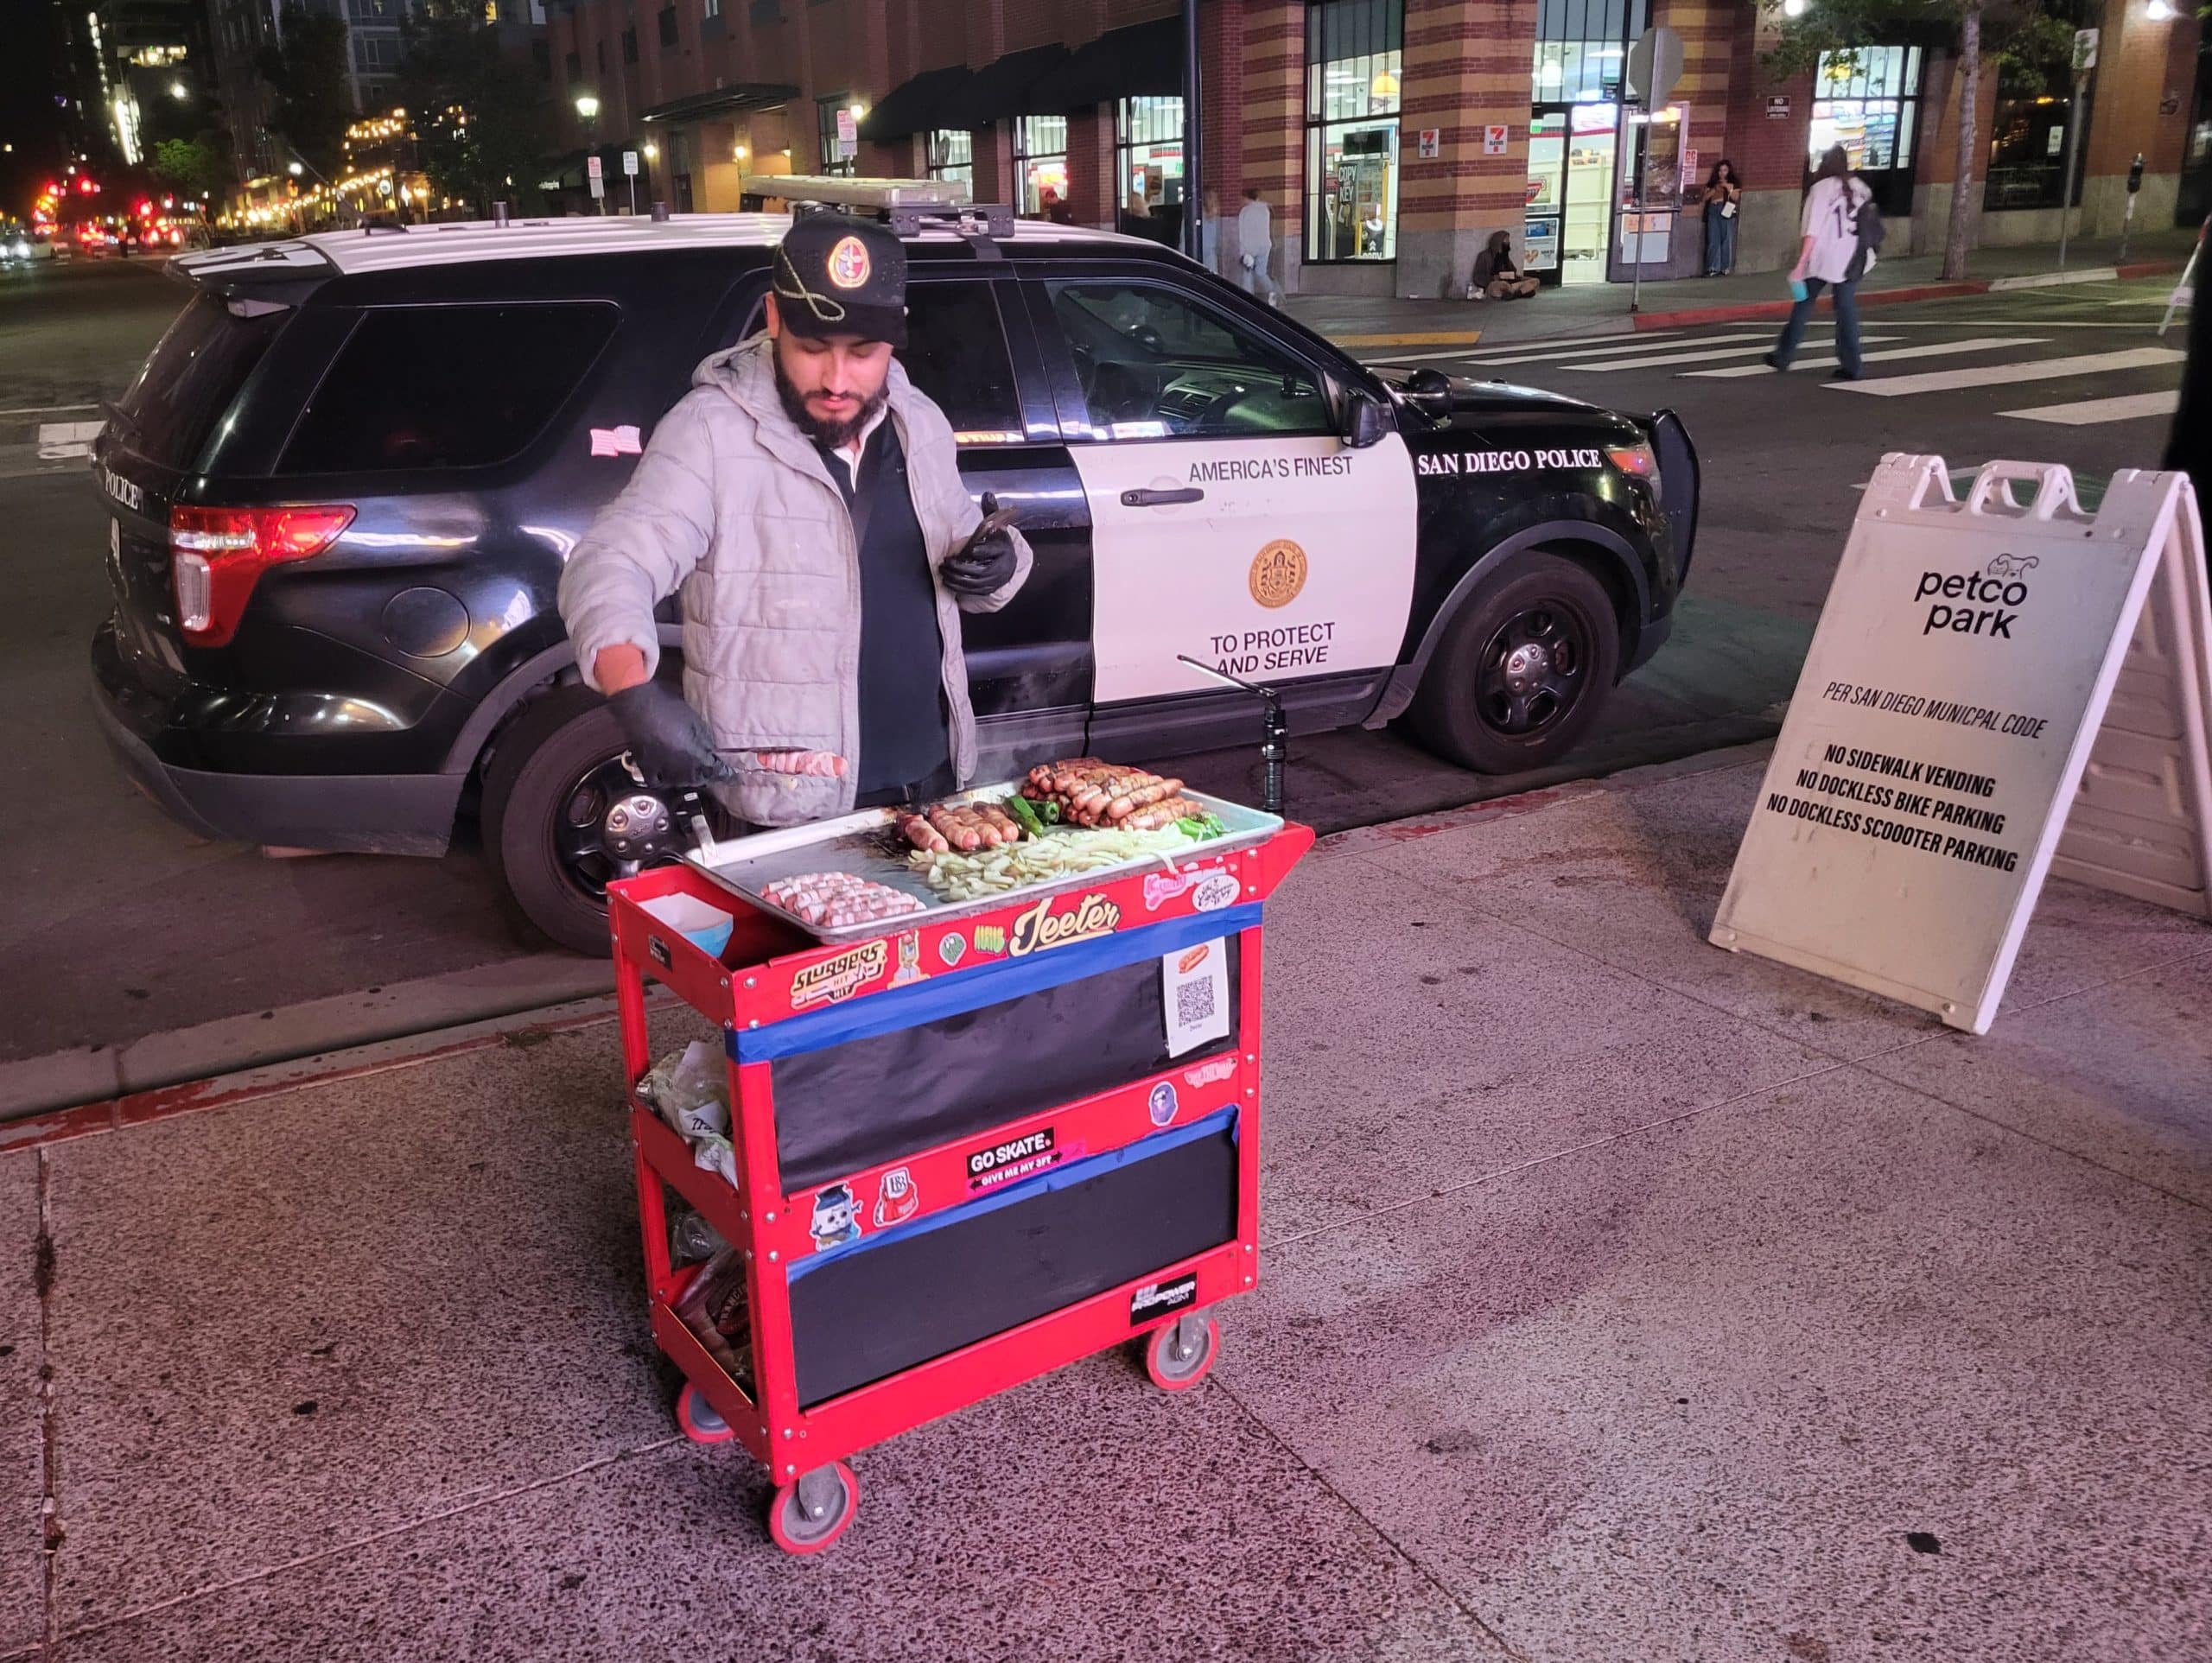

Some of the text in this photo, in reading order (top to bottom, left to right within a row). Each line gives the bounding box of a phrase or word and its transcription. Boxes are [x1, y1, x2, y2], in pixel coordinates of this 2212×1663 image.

[1338, 165, 1357, 183] COPY
[1339, 186, 1354, 202] KEY
[1189, 456, 1352, 482] AMERICA'S FINEST
[1418, 449, 1601, 474] SAN DIEGO POLICE
[105, 467, 138, 510] POLICE
[1914, 570, 2027, 606] petco
[1211, 622, 1335, 654] TO PROTECT
[1923, 604, 2018, 639] park
[1217, 645, 1328, 675] AND SERVE
[1822, 682, 2048, 739] PER SAN DIEGO MUNICPAL CODE
[1824, 744, 1995, 797] NO SIDEWALK VENDING
[1796, 769, 2005, 835] NO DOCKLESS BIKE PARKING
[1766, 793, 2018, 873] NO DOCKLESS SCOOOTER PARKING
[1009, 896, 1120, 957] Jeeter
[971, 1152, 995, 1171] GO
[981, 1171, 1002, 1185] GIVE
[1005, 1166, 1019, 1178] ME
[1020, 1162, 1035, 1174] MY
